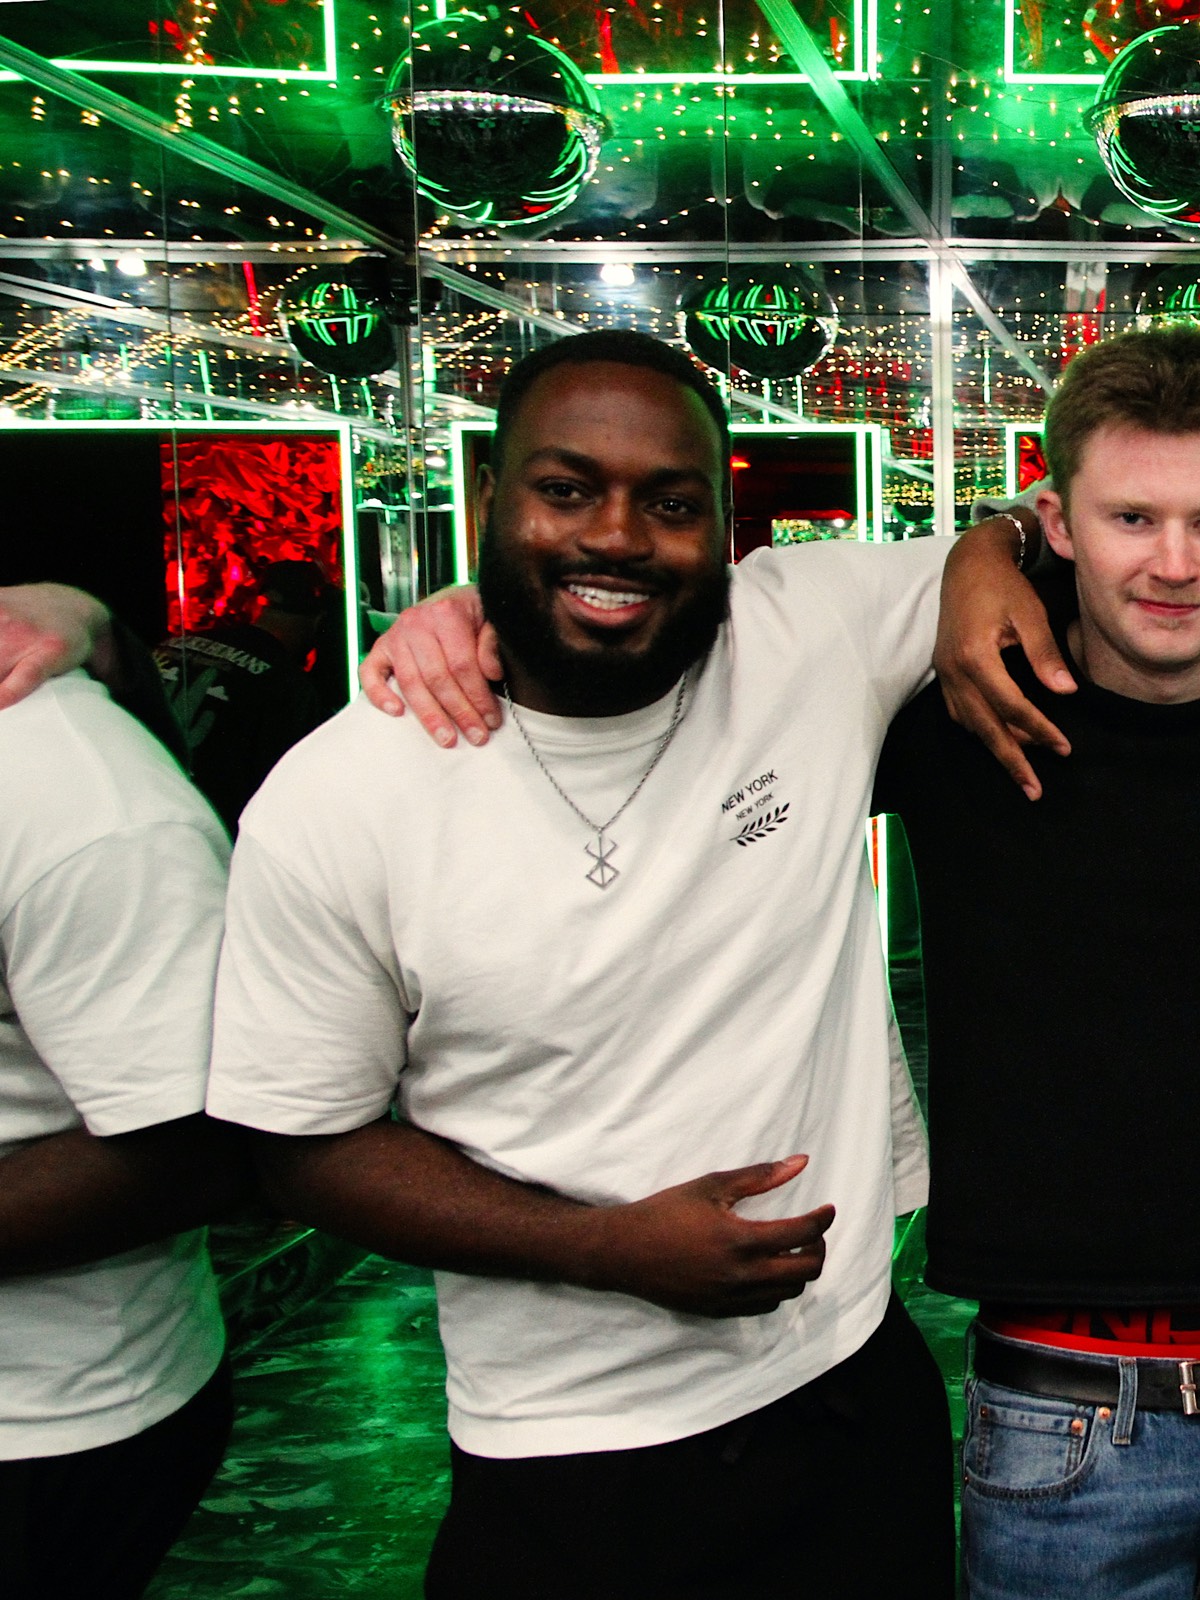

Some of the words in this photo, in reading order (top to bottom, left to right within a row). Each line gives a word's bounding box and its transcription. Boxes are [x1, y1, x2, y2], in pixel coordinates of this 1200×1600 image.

[721, 789, 745, 813] NEW
[745, 769, 778, 795] YORK
[735, 804, 753, 821] NEW
[755, 791, 774, 808] YORK
